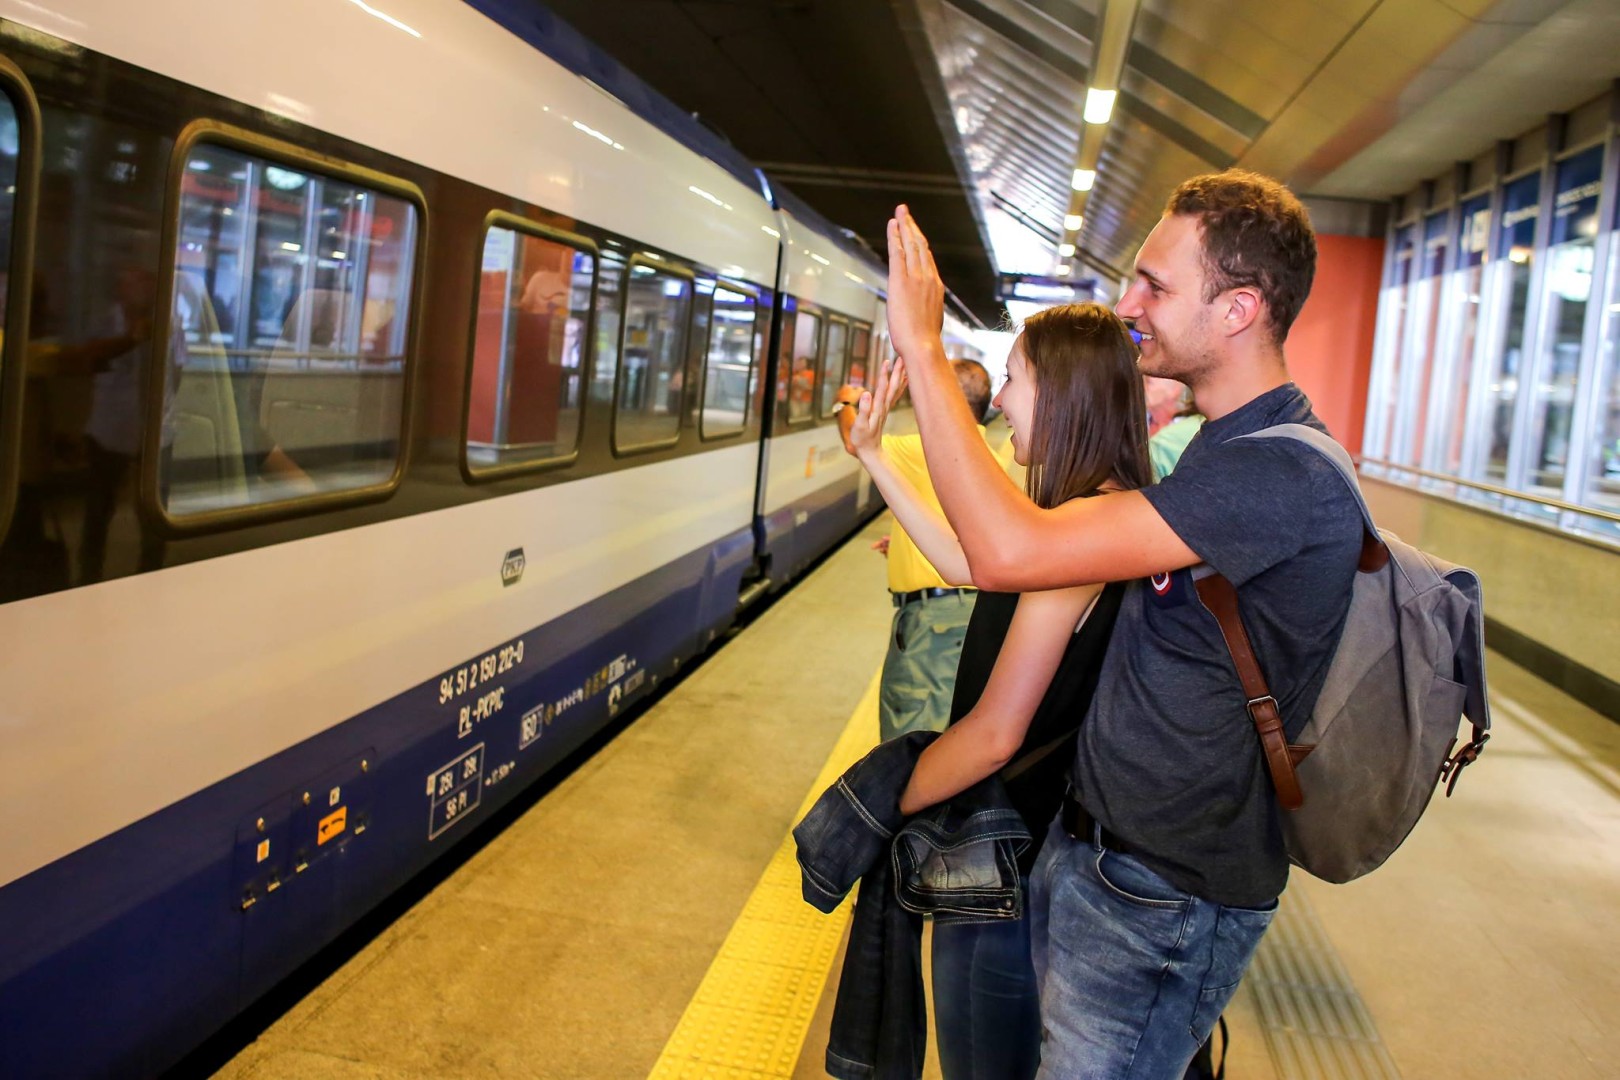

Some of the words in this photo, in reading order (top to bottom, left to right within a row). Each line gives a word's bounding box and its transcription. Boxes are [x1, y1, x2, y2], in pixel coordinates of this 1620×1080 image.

[439, 674, 454, 704] 94
[456, 667, 468, 695] 51
[469, 663, 478, 689] 2
[480, 654, 497, 683] 150
[498, 640, 524, 674] 212-0
